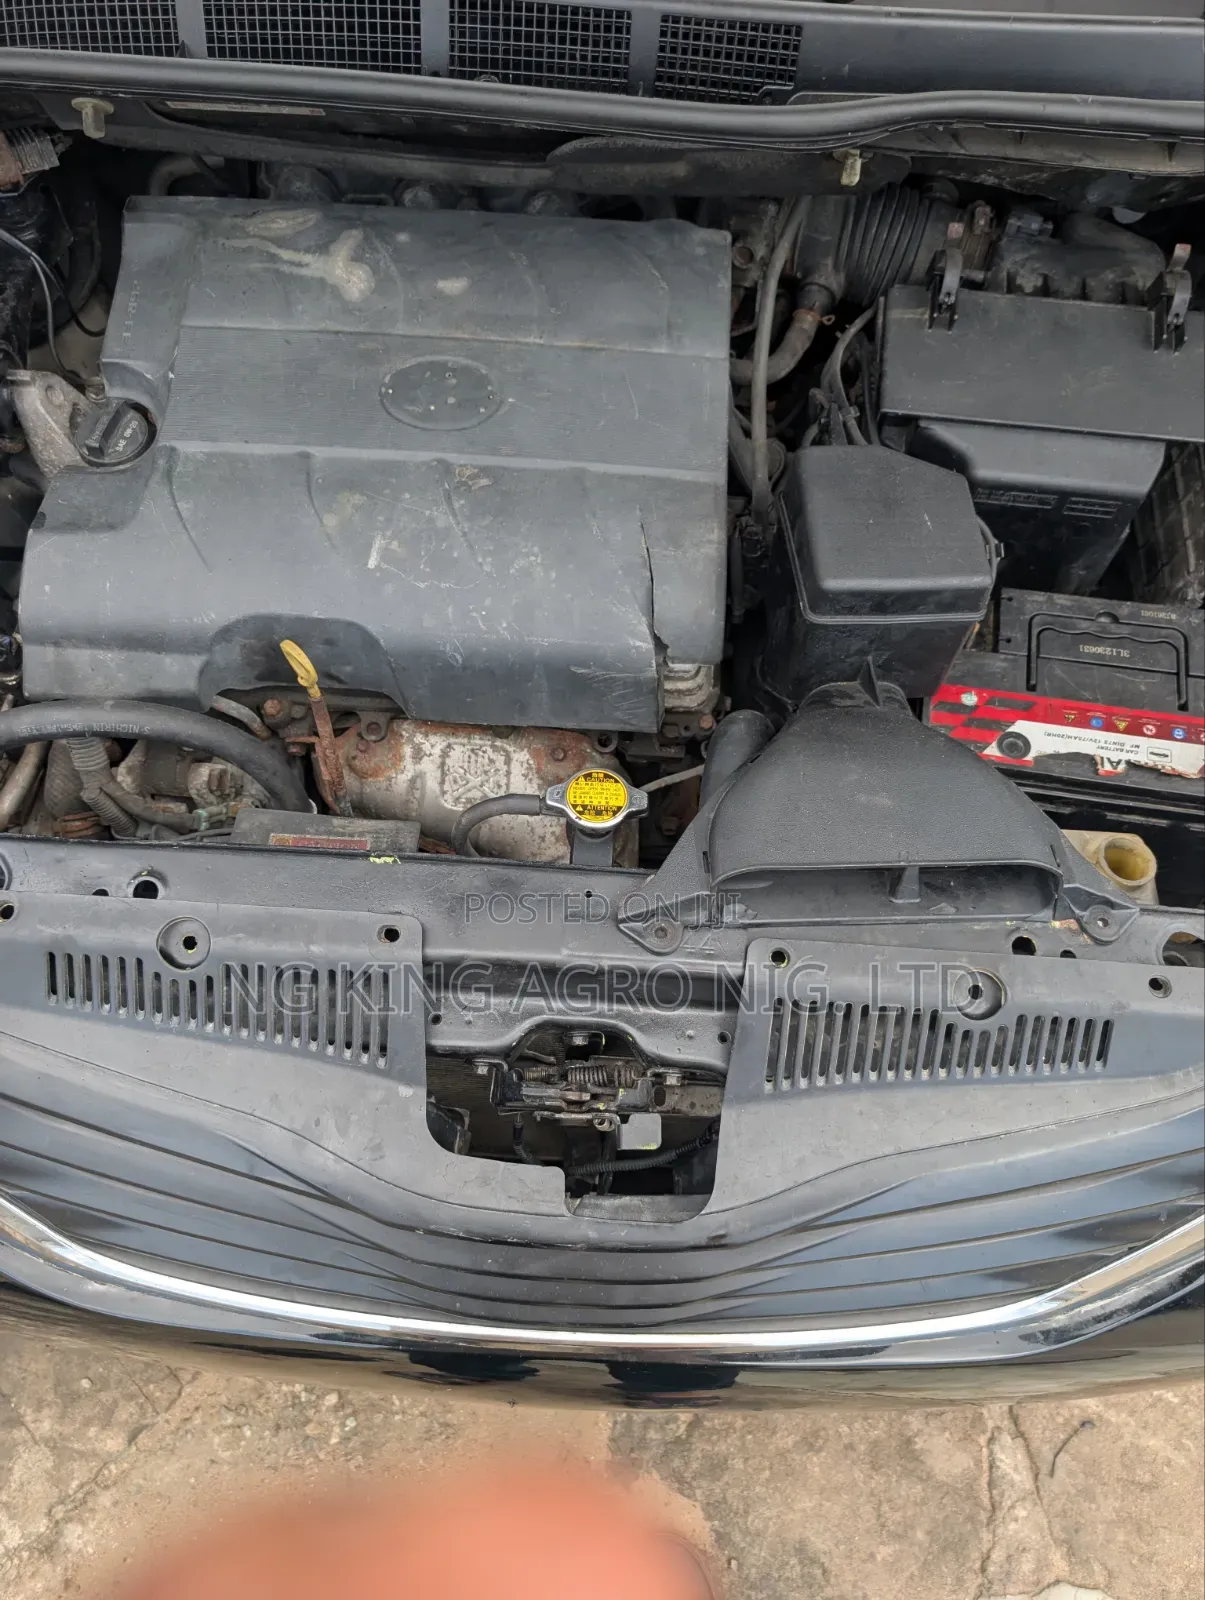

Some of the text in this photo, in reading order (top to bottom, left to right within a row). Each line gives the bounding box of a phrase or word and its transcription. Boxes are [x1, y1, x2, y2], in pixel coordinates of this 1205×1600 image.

[115, 420, 139, 452] SAE 0W-20
[1079, 644, 1130, 658] 3L1230631
[1096, 744, 1124, 753] BATTERY
